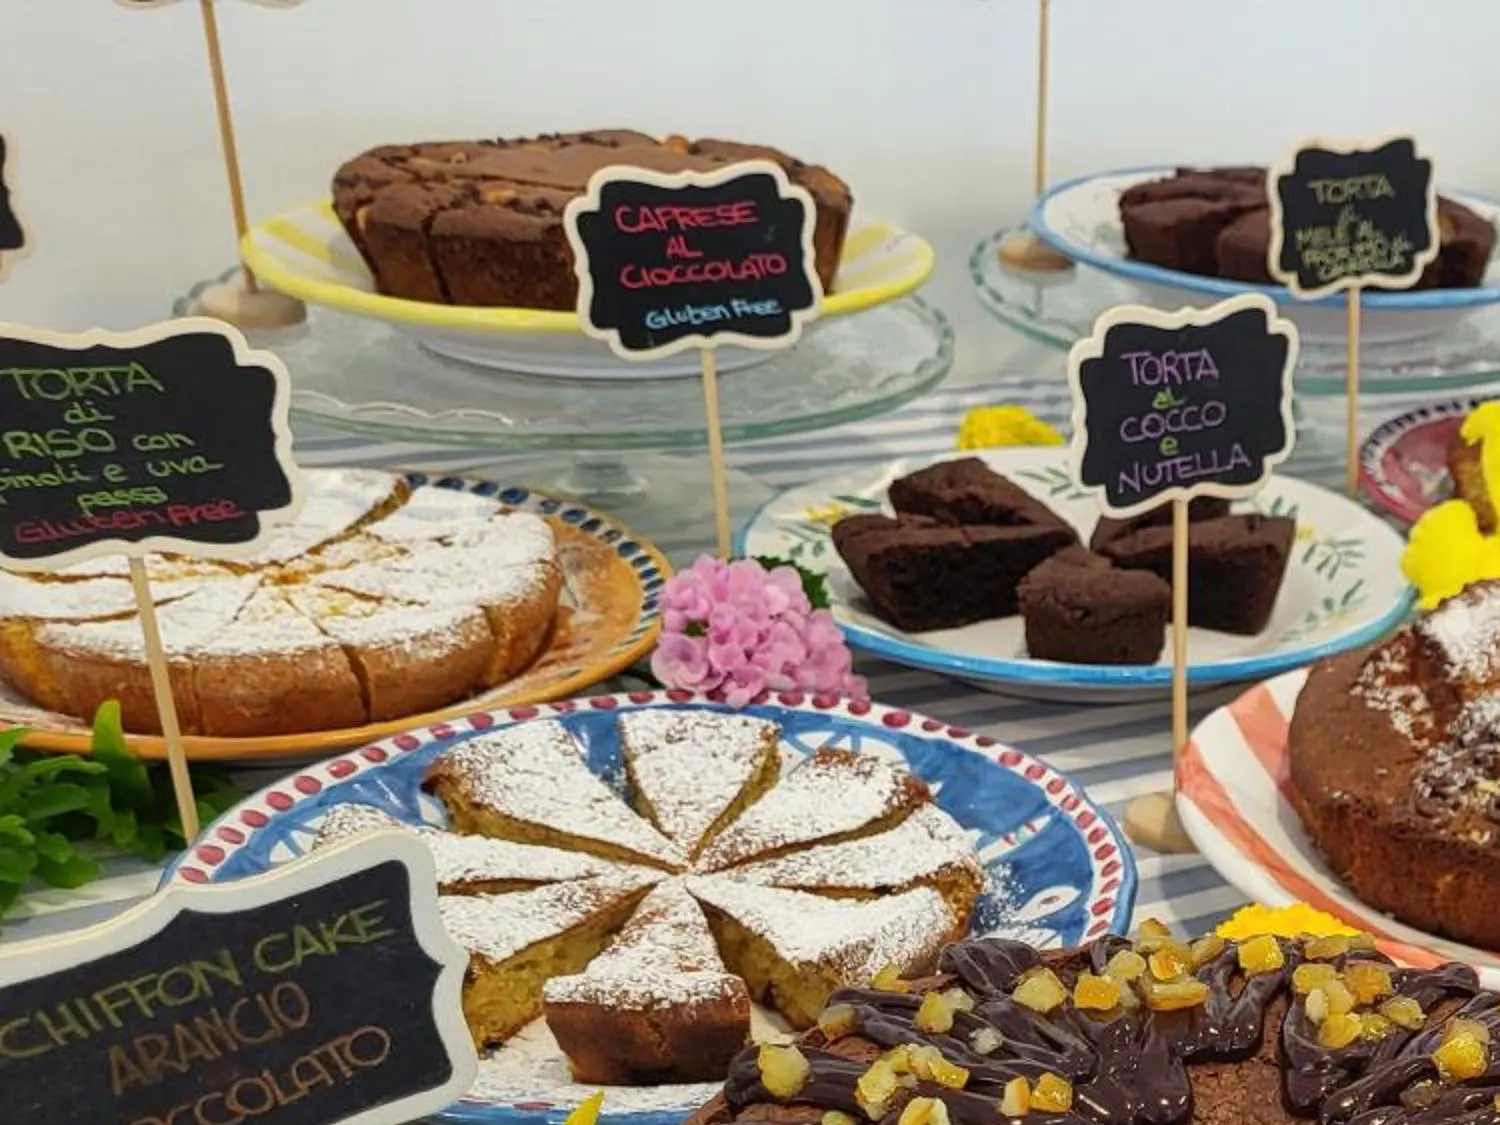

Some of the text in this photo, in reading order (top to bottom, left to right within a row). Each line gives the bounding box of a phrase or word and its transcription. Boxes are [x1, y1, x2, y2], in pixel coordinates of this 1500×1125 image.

[1306, 175, 1395, 204] TORTA
[613, 201, 760, 233] CAPRESE
[666, 236, 703, 259] AL
[619, 254, 788, 289] CIOCCOLATO
[645, 298, 782, 329] Gluten Free
[0, 362, 165, 400] TORTA
[1120, 348, 1219, 386] TORTA
[63, 401, 115, 424] di
[1120, 401, 1227, 443] COCCO
[3, 428, 195, 459] RISO con
[1159, 436, 1179, 456] e
[103, 464, 128, 483] e
[146, 456, 224, 477] uva
[1118, 443, 1251, 494] NUTELLA
[14, 500, 247, 543] Gluten Free
[0, 900, 396, 1058] CHIFFON CAKE
[106, 981, 310, 1096] ARANCIO
